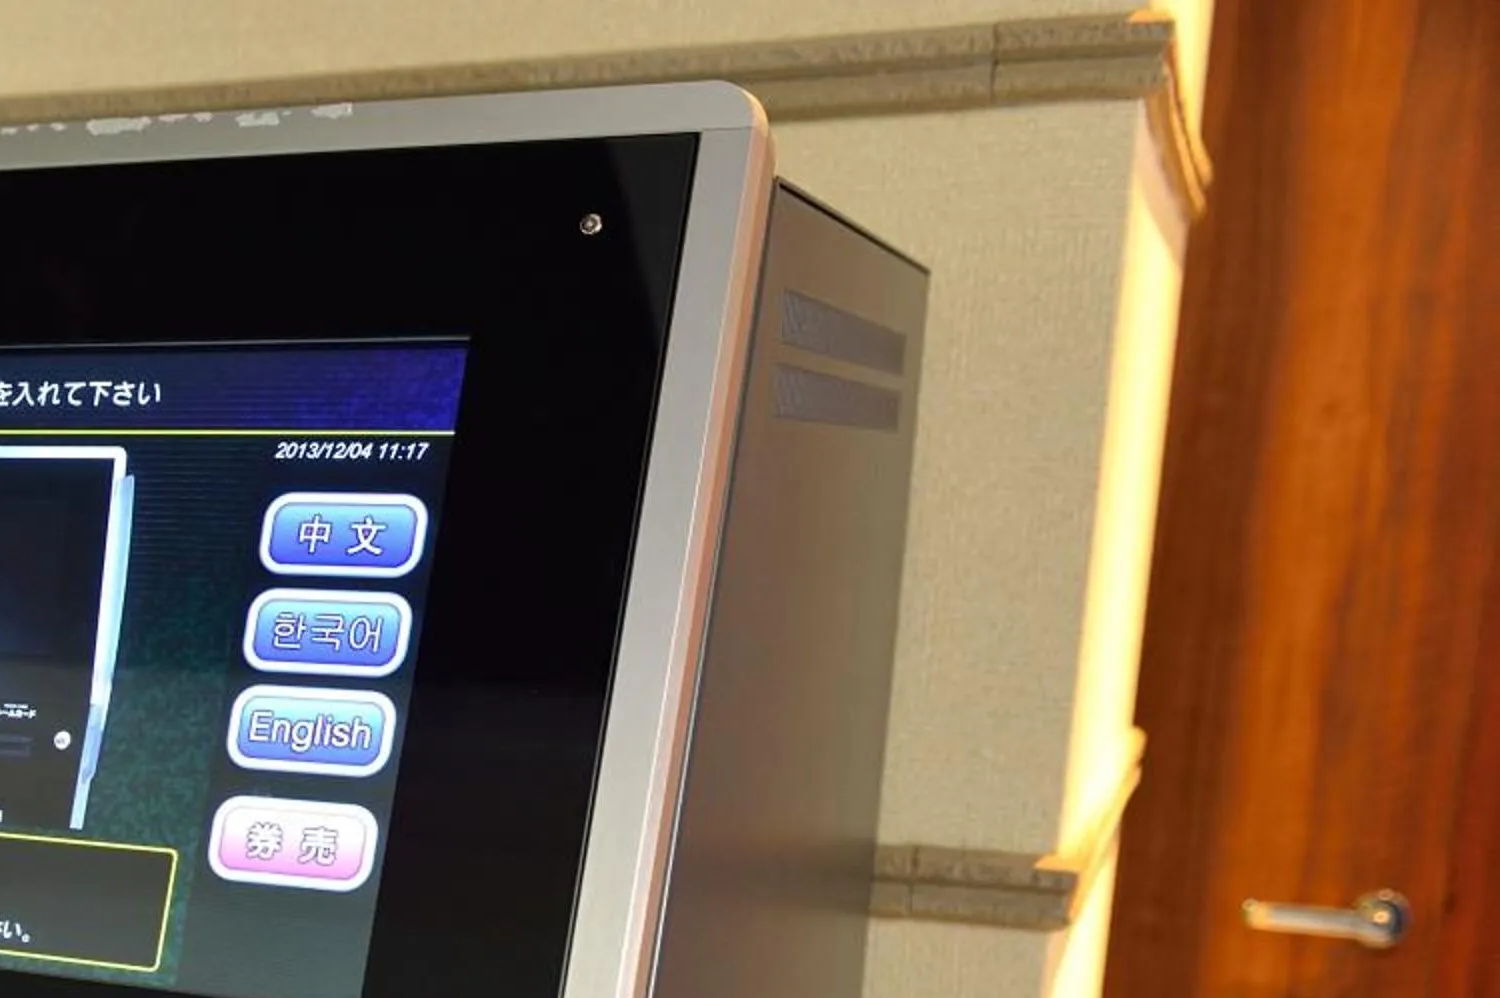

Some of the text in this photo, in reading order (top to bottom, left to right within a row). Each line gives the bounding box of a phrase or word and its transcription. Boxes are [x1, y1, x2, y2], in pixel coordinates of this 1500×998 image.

[275, 441, 430, 460] 2013/12/04 11:17
[273, 612, 383, 653] 한국어
[249, 710, 372, 752] English
